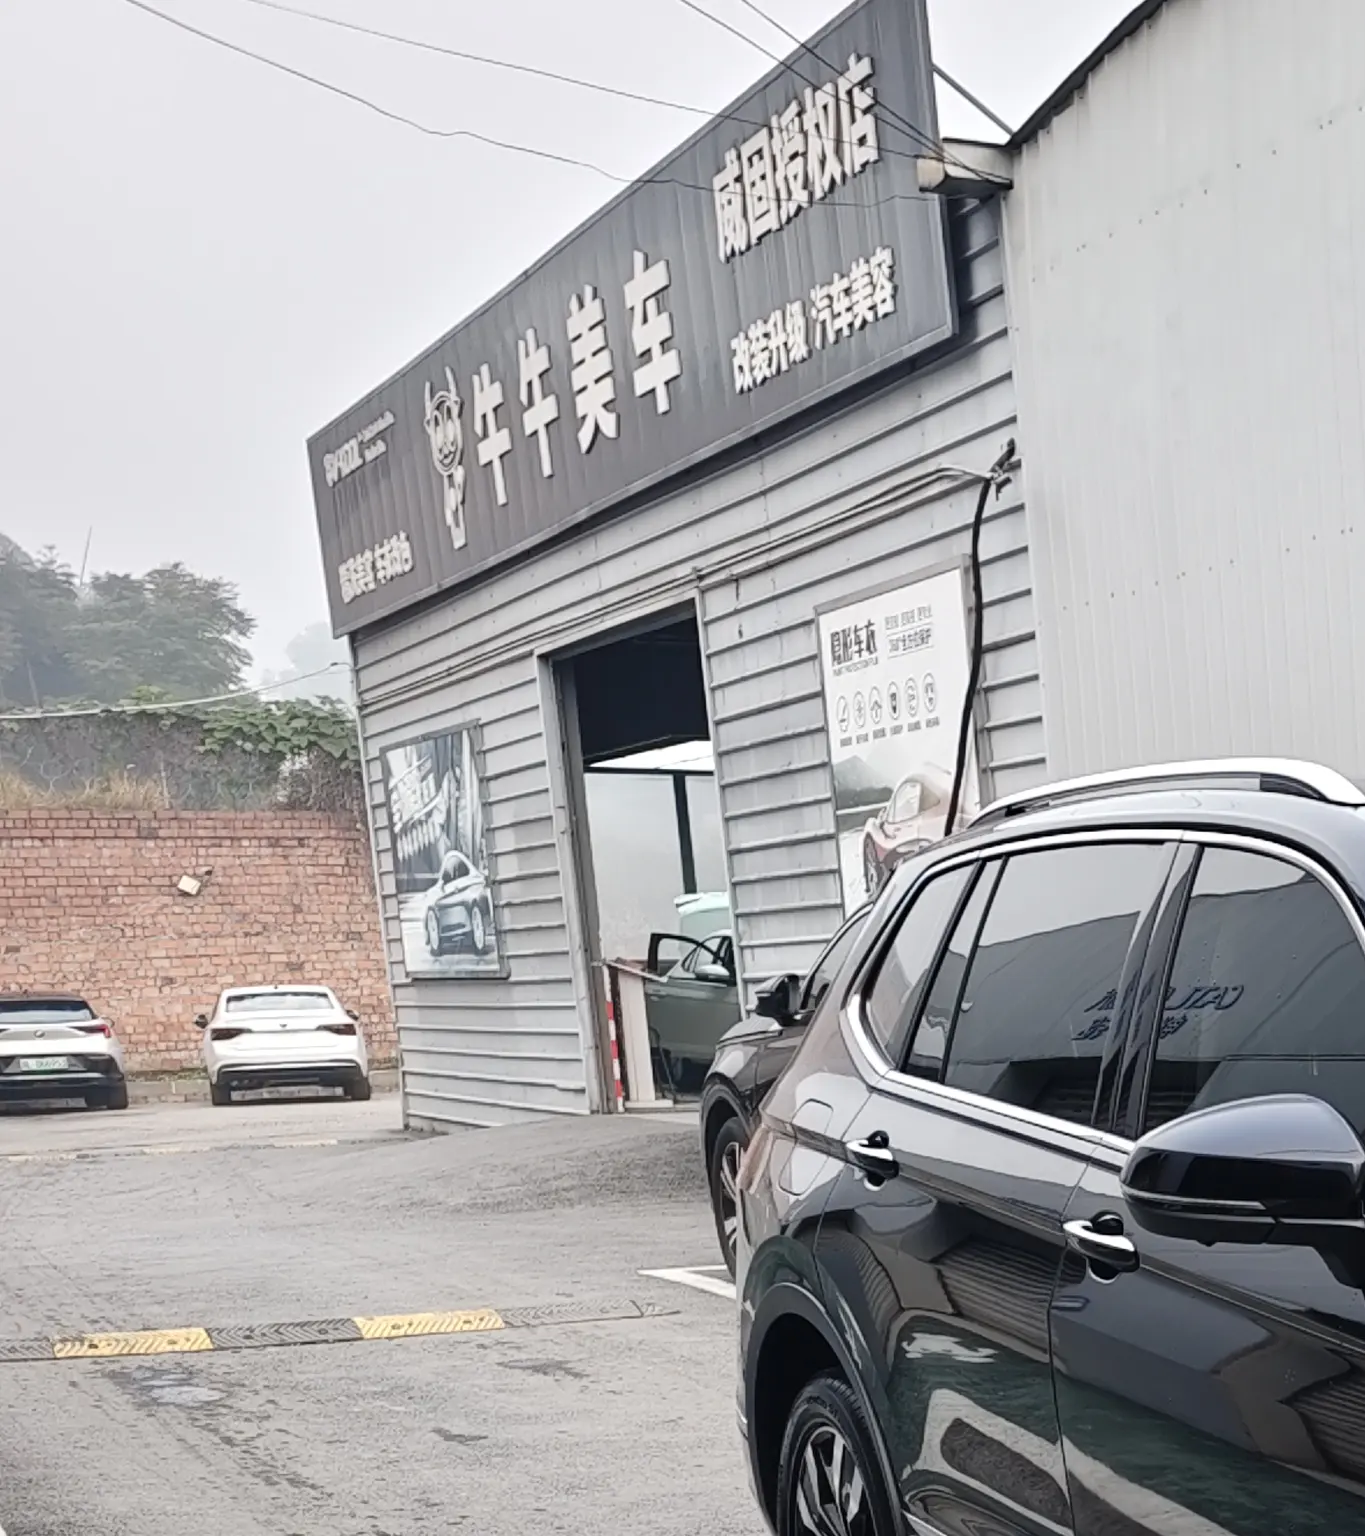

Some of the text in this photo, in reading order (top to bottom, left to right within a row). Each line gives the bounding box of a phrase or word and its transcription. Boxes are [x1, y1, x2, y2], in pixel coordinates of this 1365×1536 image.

[712, 52, 880, 263] 威固授权店
[472, 250, 682, 506] 牛牛美车
[731, 246, 897, 394] 改装升级 汽车美容
